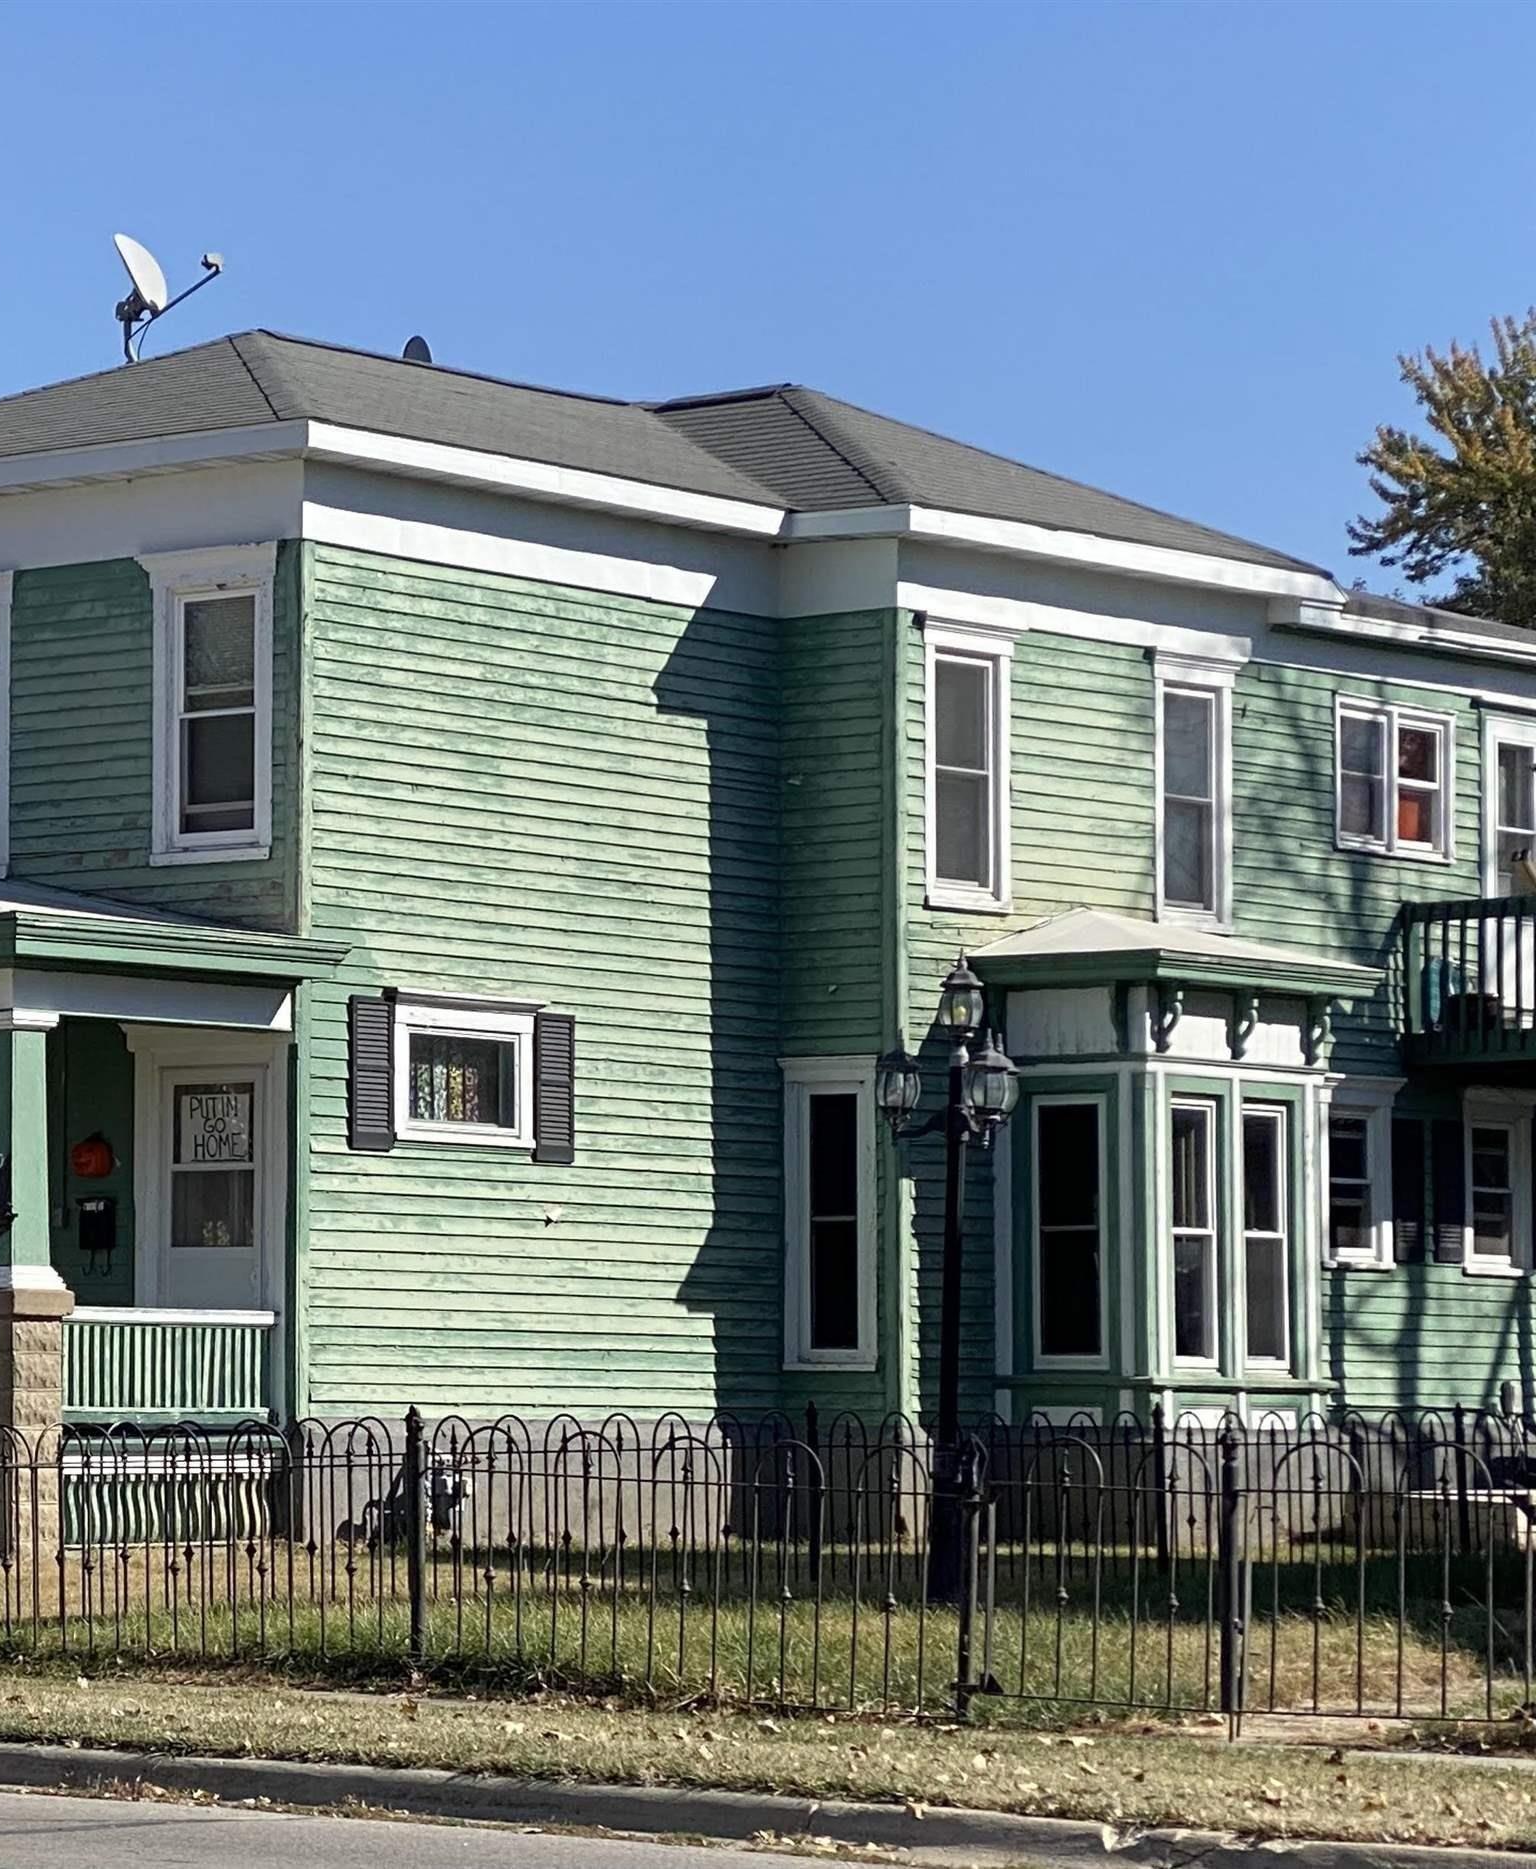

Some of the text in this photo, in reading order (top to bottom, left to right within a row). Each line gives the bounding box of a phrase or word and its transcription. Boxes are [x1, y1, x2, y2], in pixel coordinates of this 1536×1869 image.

[189, 1095, 239, 1120] PUTIN
[203, 1117, 227, 1134] GO
[193, 1132, 249, 1160] HOME
